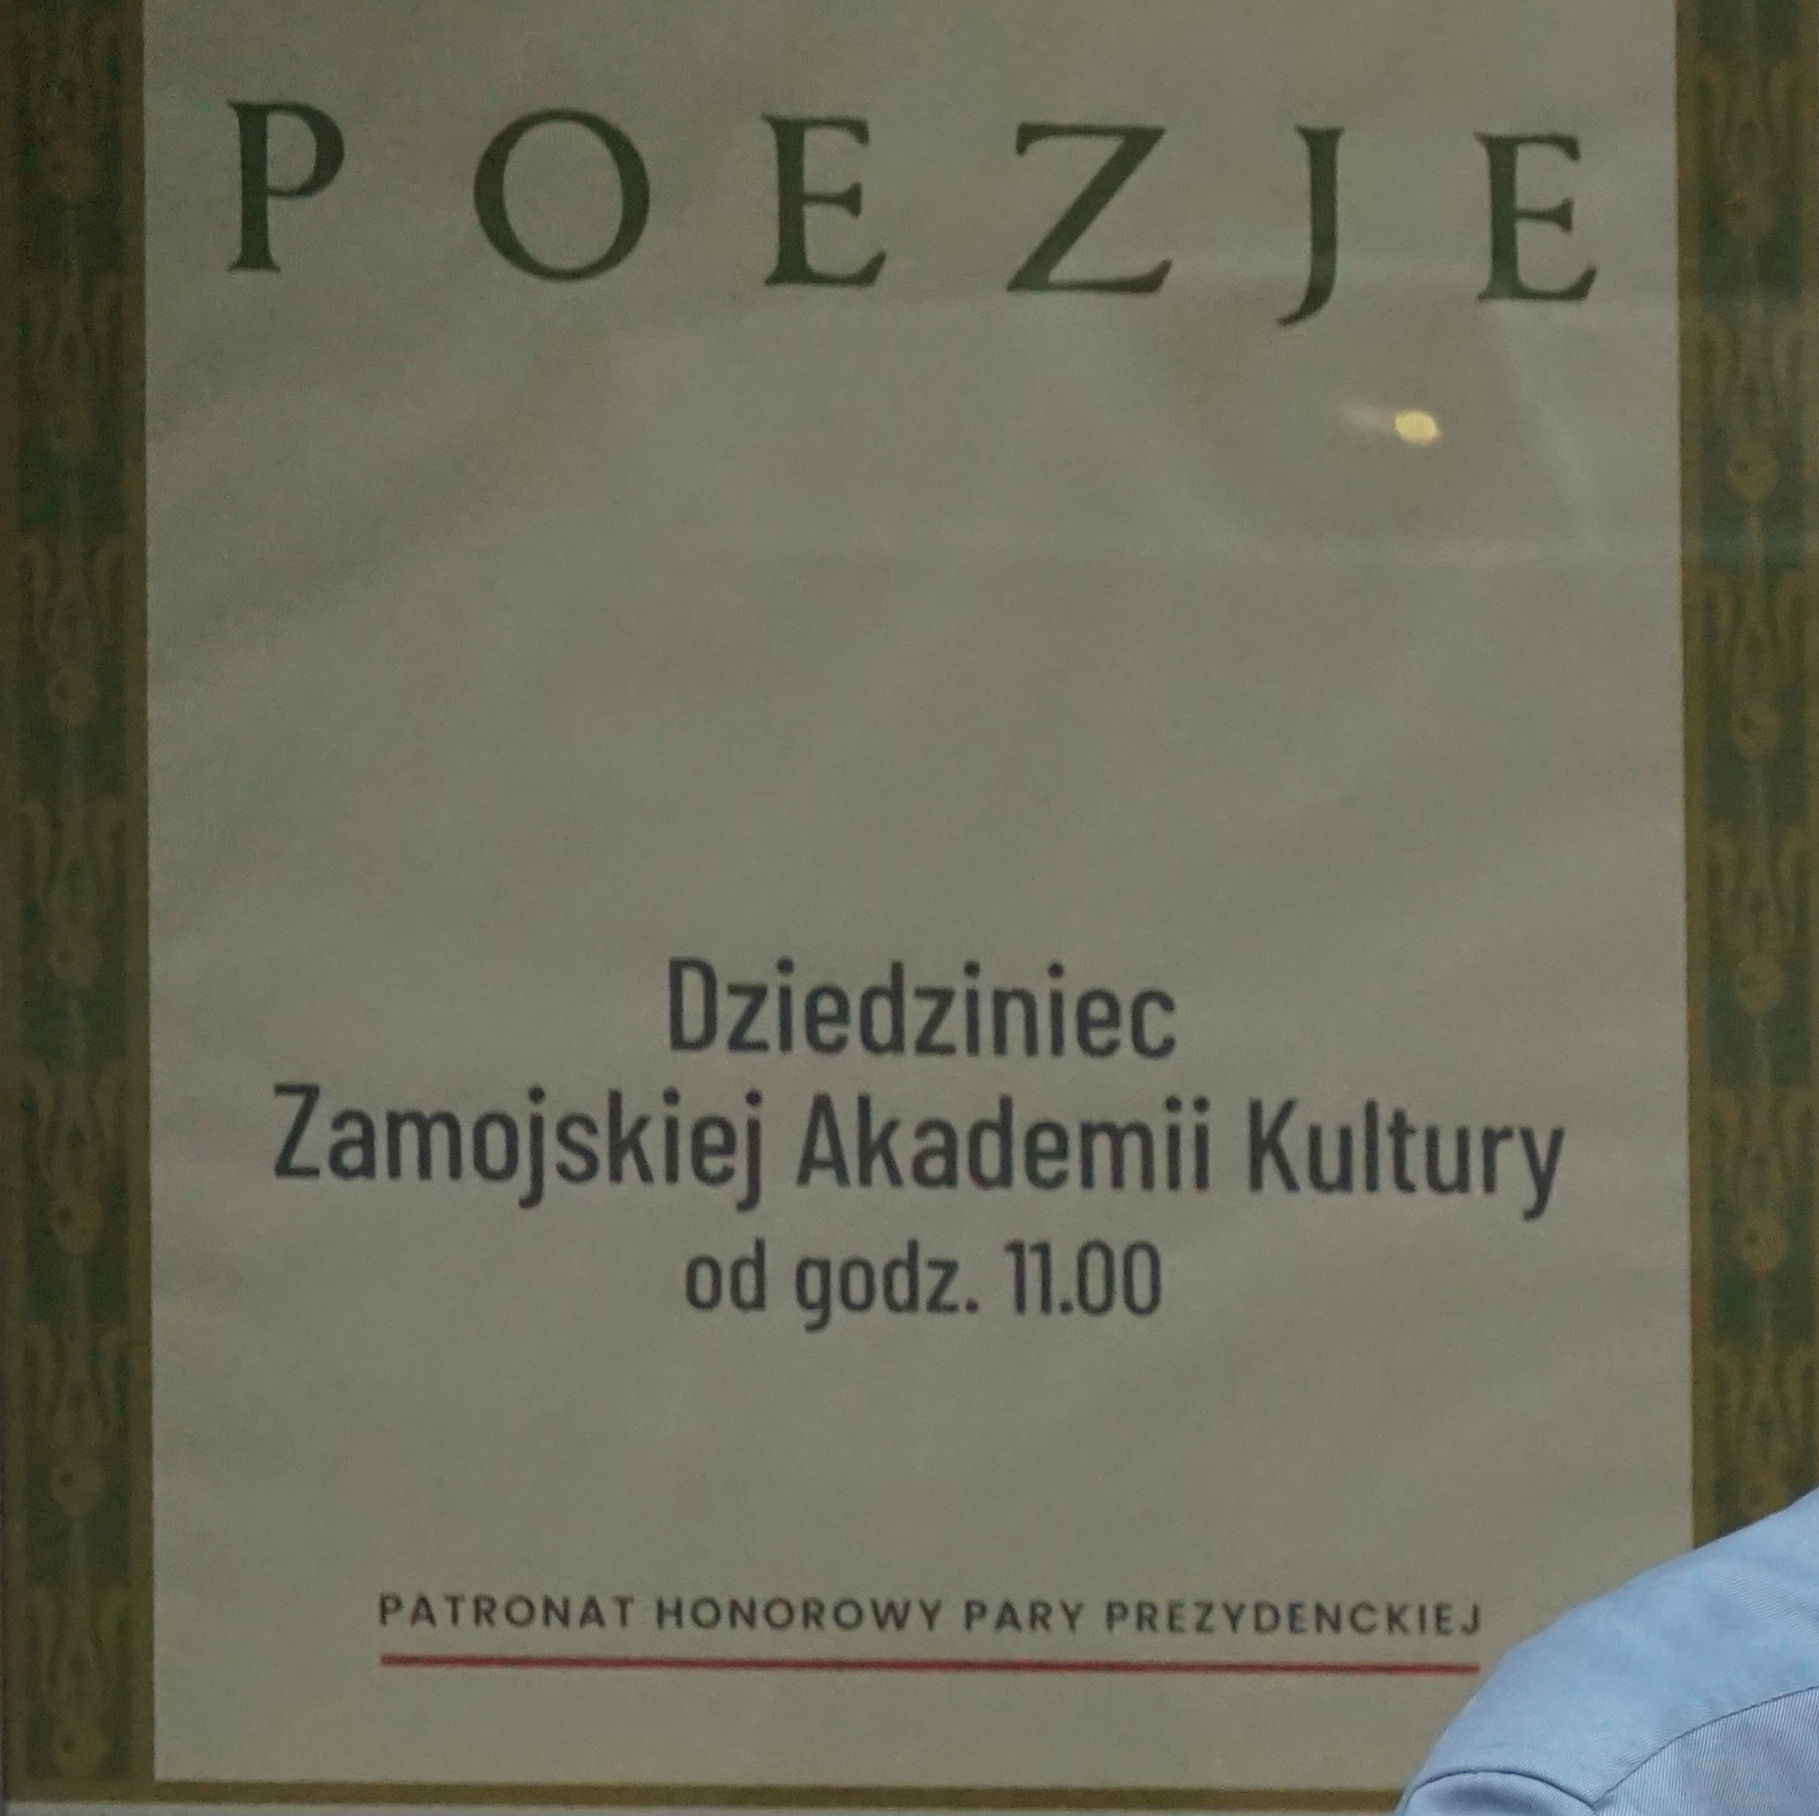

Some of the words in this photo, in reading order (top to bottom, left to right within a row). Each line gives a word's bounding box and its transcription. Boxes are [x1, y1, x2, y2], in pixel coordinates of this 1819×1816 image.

[226, 98, 1600, 330] POEZJE
[667, 953, 1178, 1062] Dziedziniec
[271, 1080, 764, 1216] Zamojskiej
[795, 1090, 1212, 1194] Akademii
[1245, 1096, 1567, 1224] Kultury
[683, 1235, 769, 1315] od
[792, 1236, 981, 1336] godz.
[1002, 1236, 1163, 1319] 11.00
[377, 1591, 636, 1630] PATRONAT
[654, 1594, 944, 1634] HONOROWY
[962, 1597, 1086, 1634] PARY
[1104, 1598, 1482, 1638] PREZYDENCKIEJ
